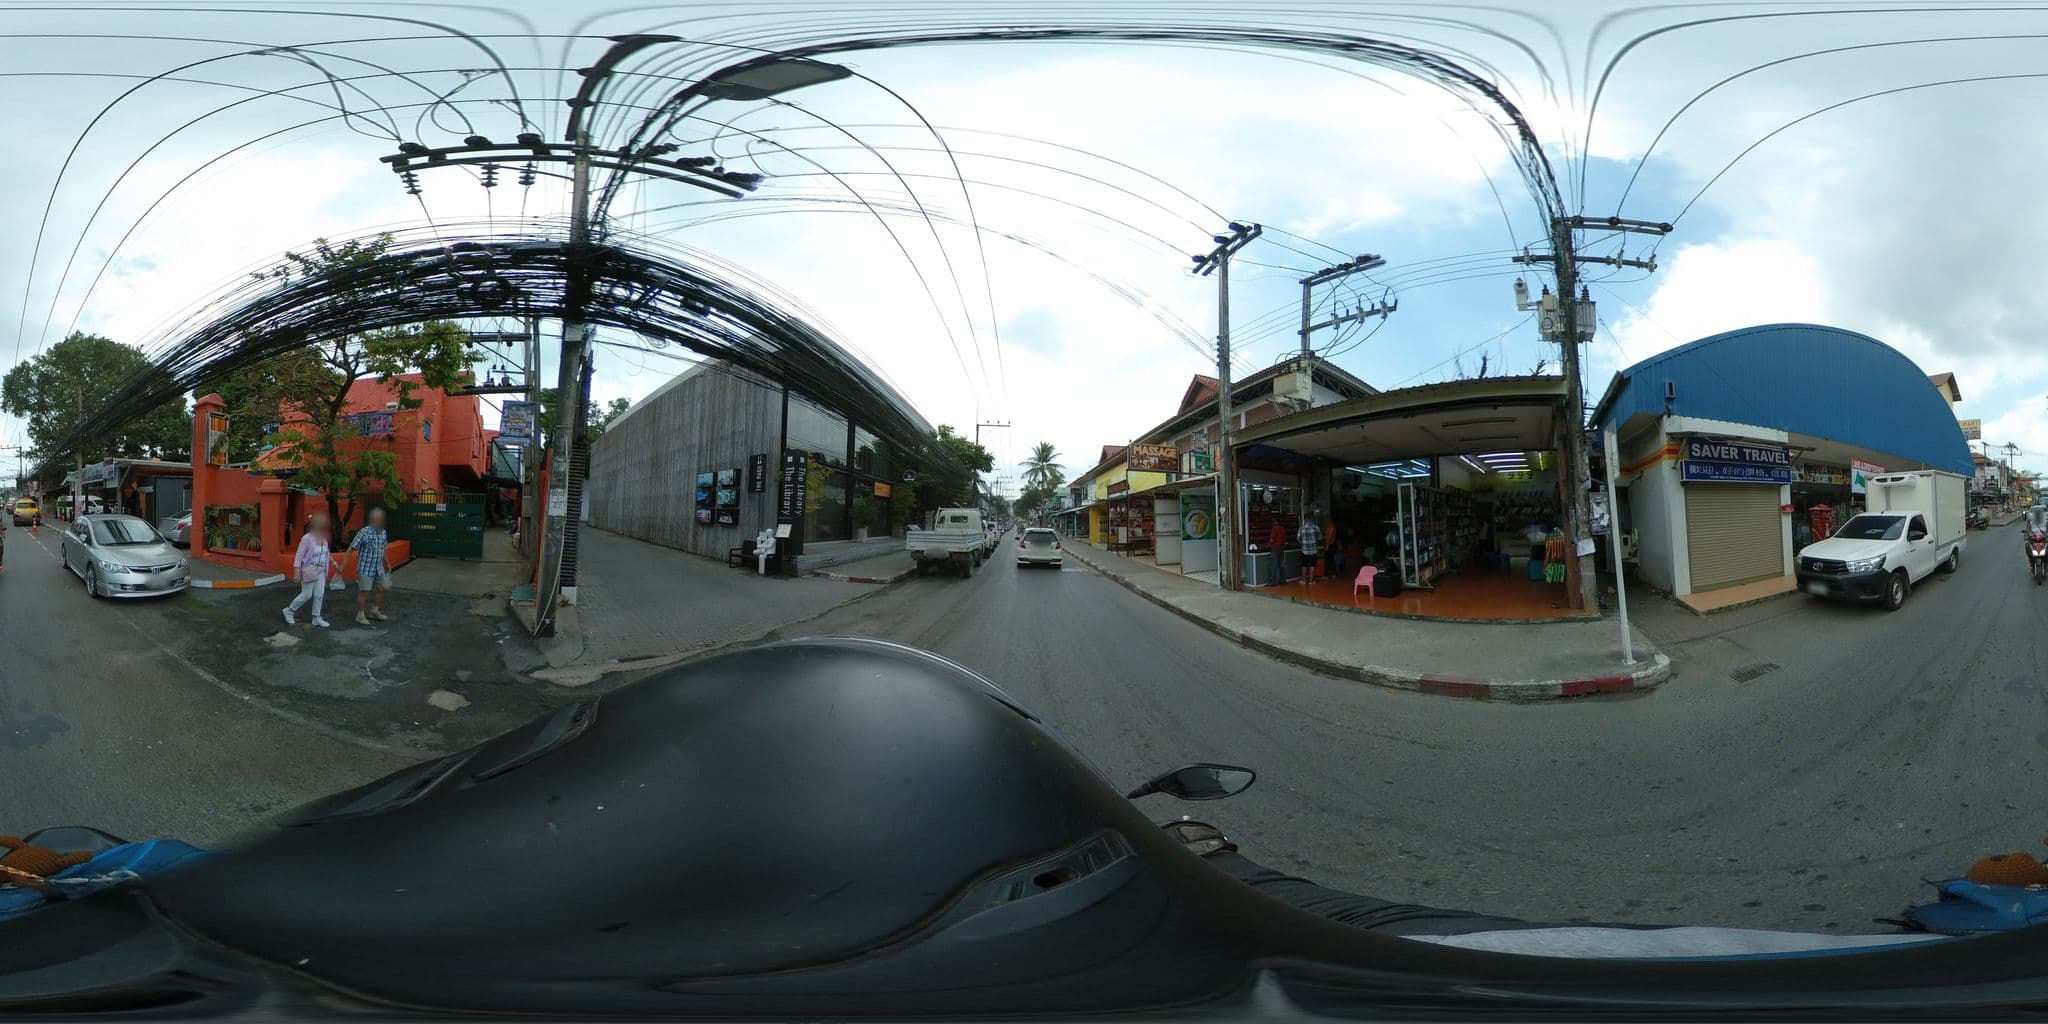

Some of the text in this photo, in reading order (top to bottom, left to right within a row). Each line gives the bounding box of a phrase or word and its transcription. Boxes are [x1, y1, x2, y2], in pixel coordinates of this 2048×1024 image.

[1133, 445, 1177, 458] MASSAGE
[1691, 443, 1789, 464] SAVER TRAVEL
[785, 466, 795, 482] The
[781, 484, 794, 515] Library
[795, 467, 807, 516] The Library
